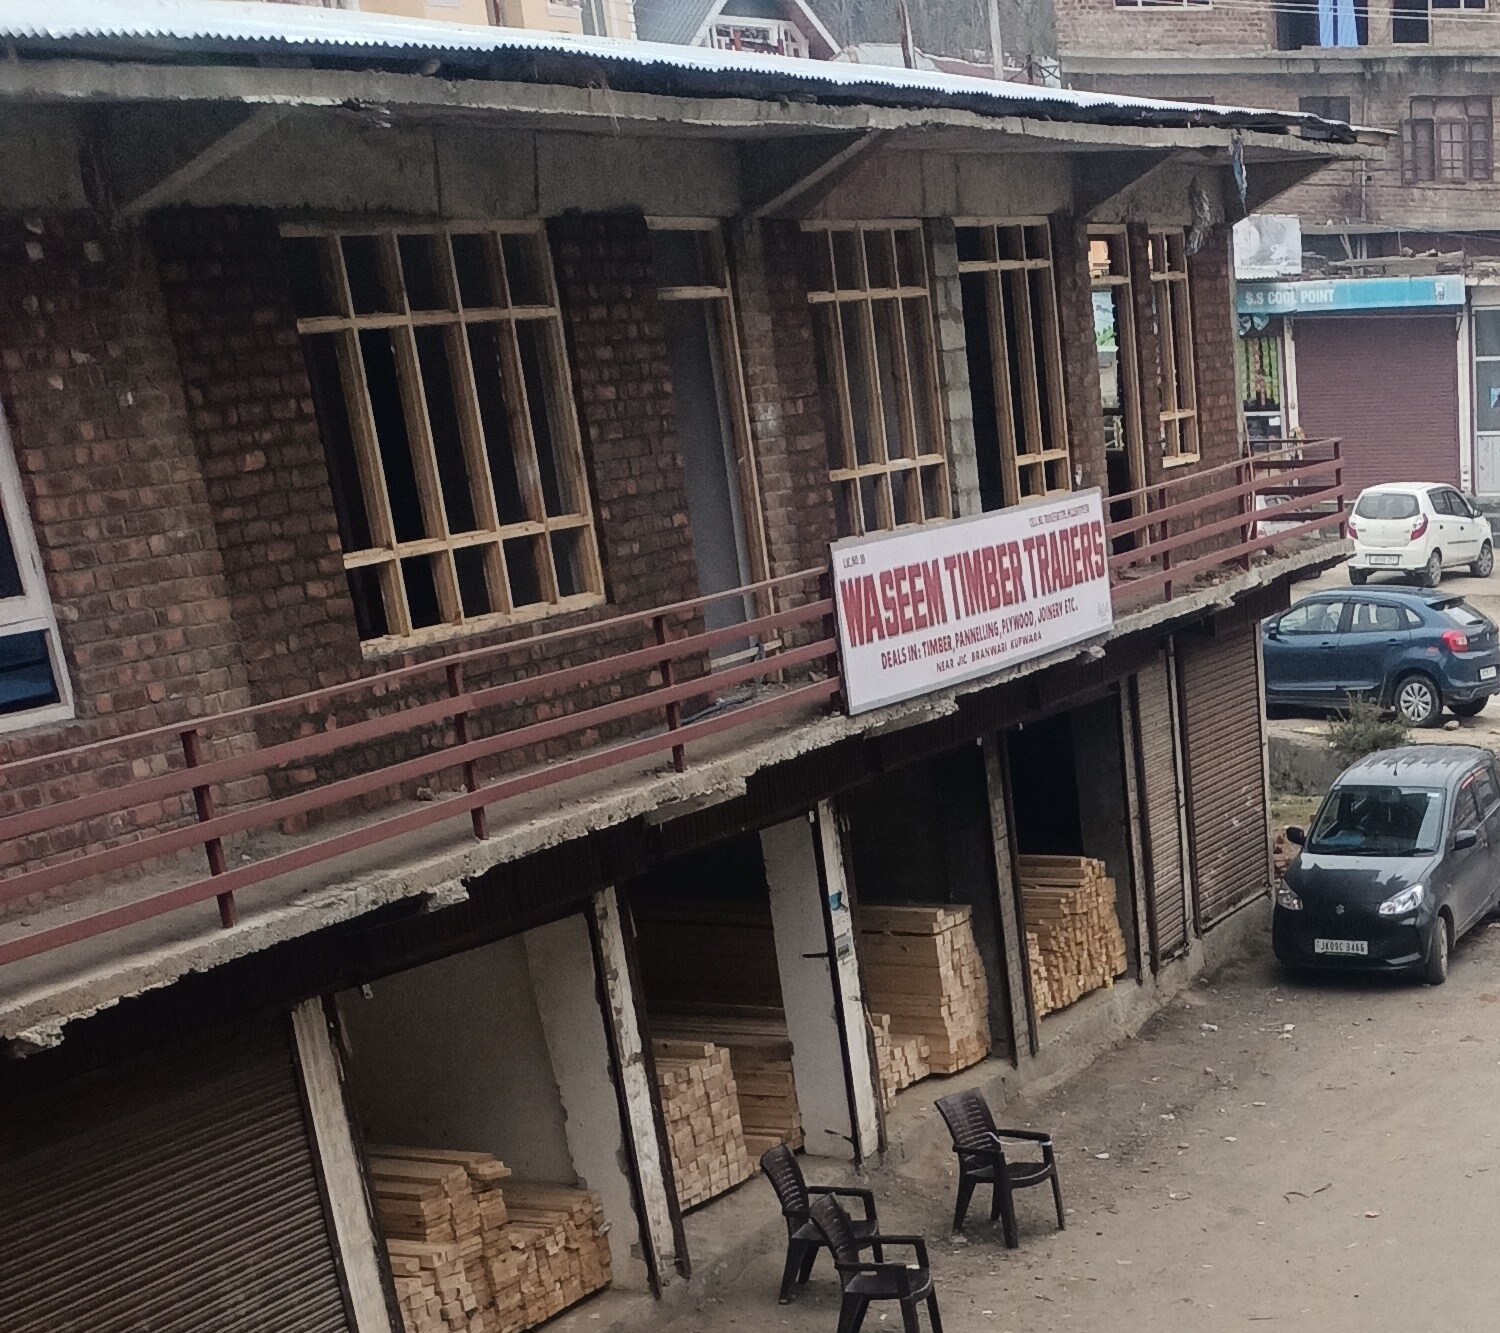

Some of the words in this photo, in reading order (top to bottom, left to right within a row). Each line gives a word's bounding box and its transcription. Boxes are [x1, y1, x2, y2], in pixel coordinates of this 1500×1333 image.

[1244, 292, 1264, 305] S.S
[1268, 290, 1298, 304] COOL
[1300, 288, 1335, 303] POINT
[840, 558, 948, 648] WASEEM
[944, 541, 1027, 621] TIMBER
[1023, 520, 1106, 599] TRADERS
[881, 649, 907, 669] DEALS
[908, 644, 922, 661] IN:
[922, 635, 956, 658] TIMBER,
[1002, 610, 1037, 633] PLYWOOD,
[1038, 601, 1063, 623] JOINERY
[1064, 597, 1079, 614] ETC.
[936, 659, 954, 673] NEAR
